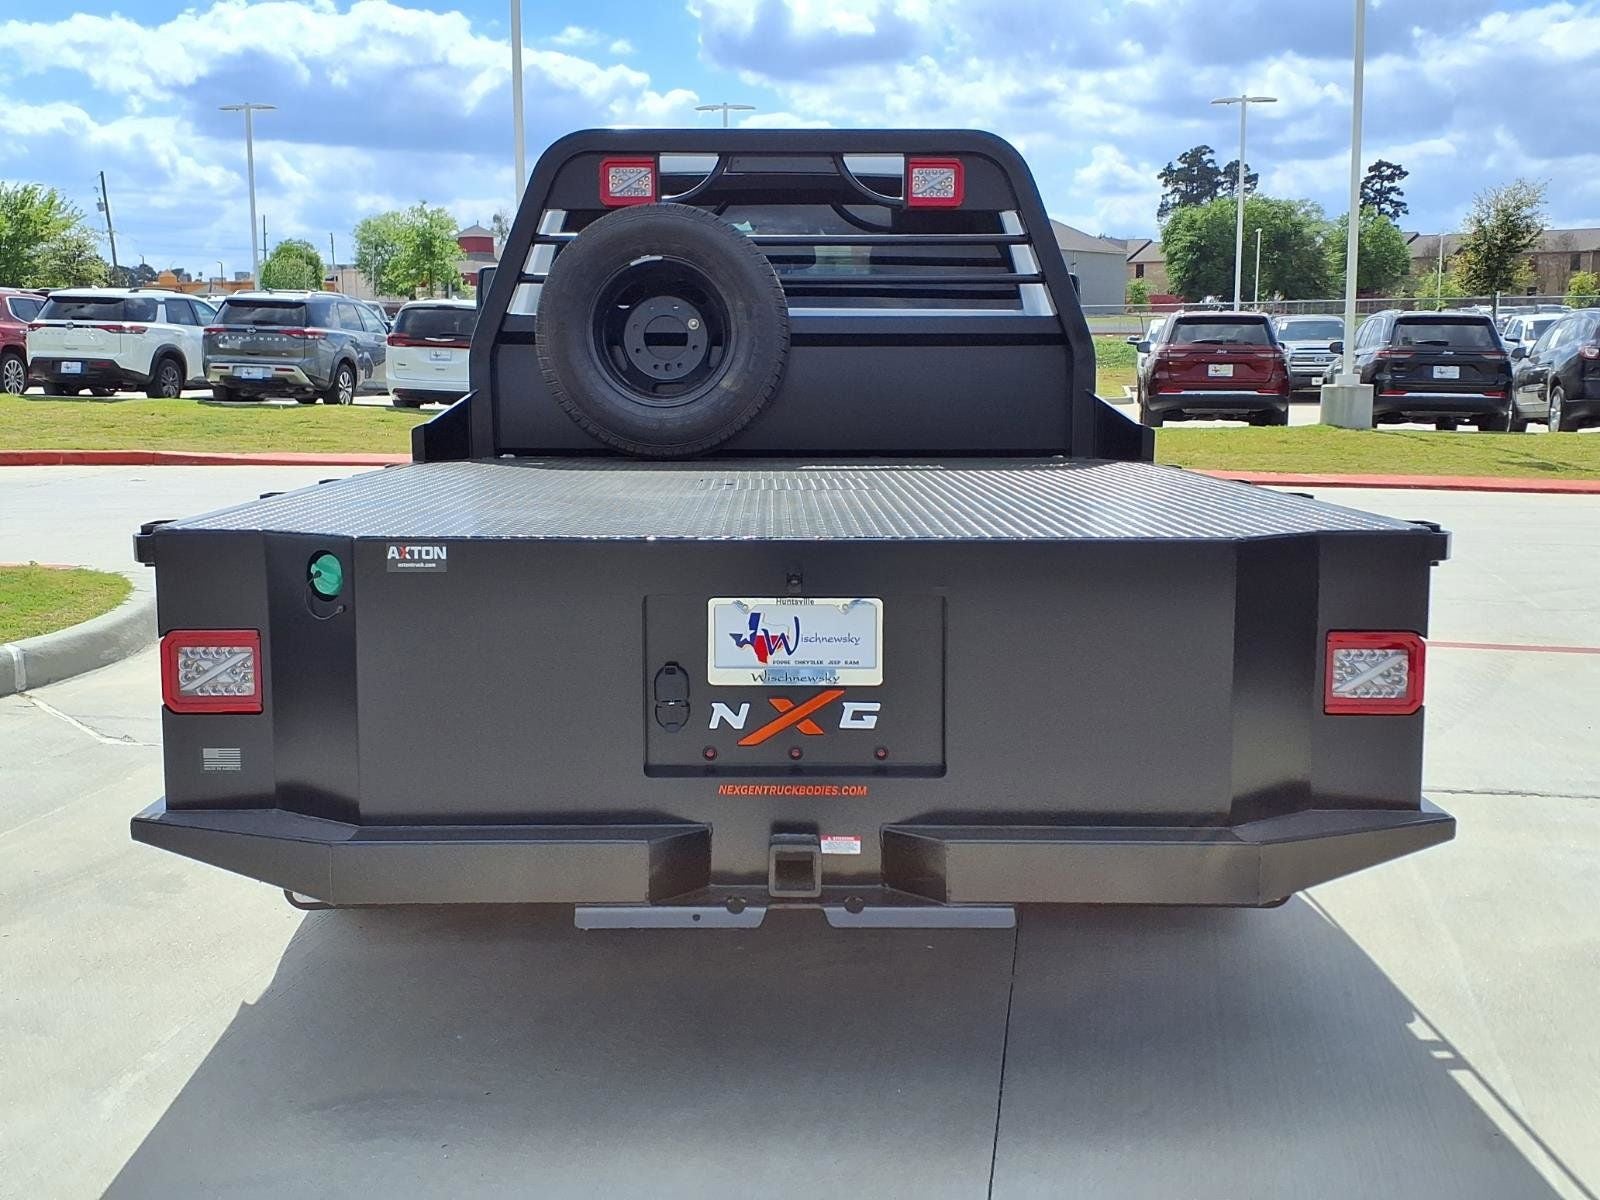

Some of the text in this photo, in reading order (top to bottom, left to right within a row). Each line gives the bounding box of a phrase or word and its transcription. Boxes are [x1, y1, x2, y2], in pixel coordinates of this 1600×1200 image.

[387, 546, 447, 560] AXTON
[775, 597, 816, 606] Huntsville
[761, 616, 861, 656] Wischnewsky
[751, 670, 841, 685] Wischnewsky
[718, 785, 868, 796] NEXGENTRUCKBODIES.COM
